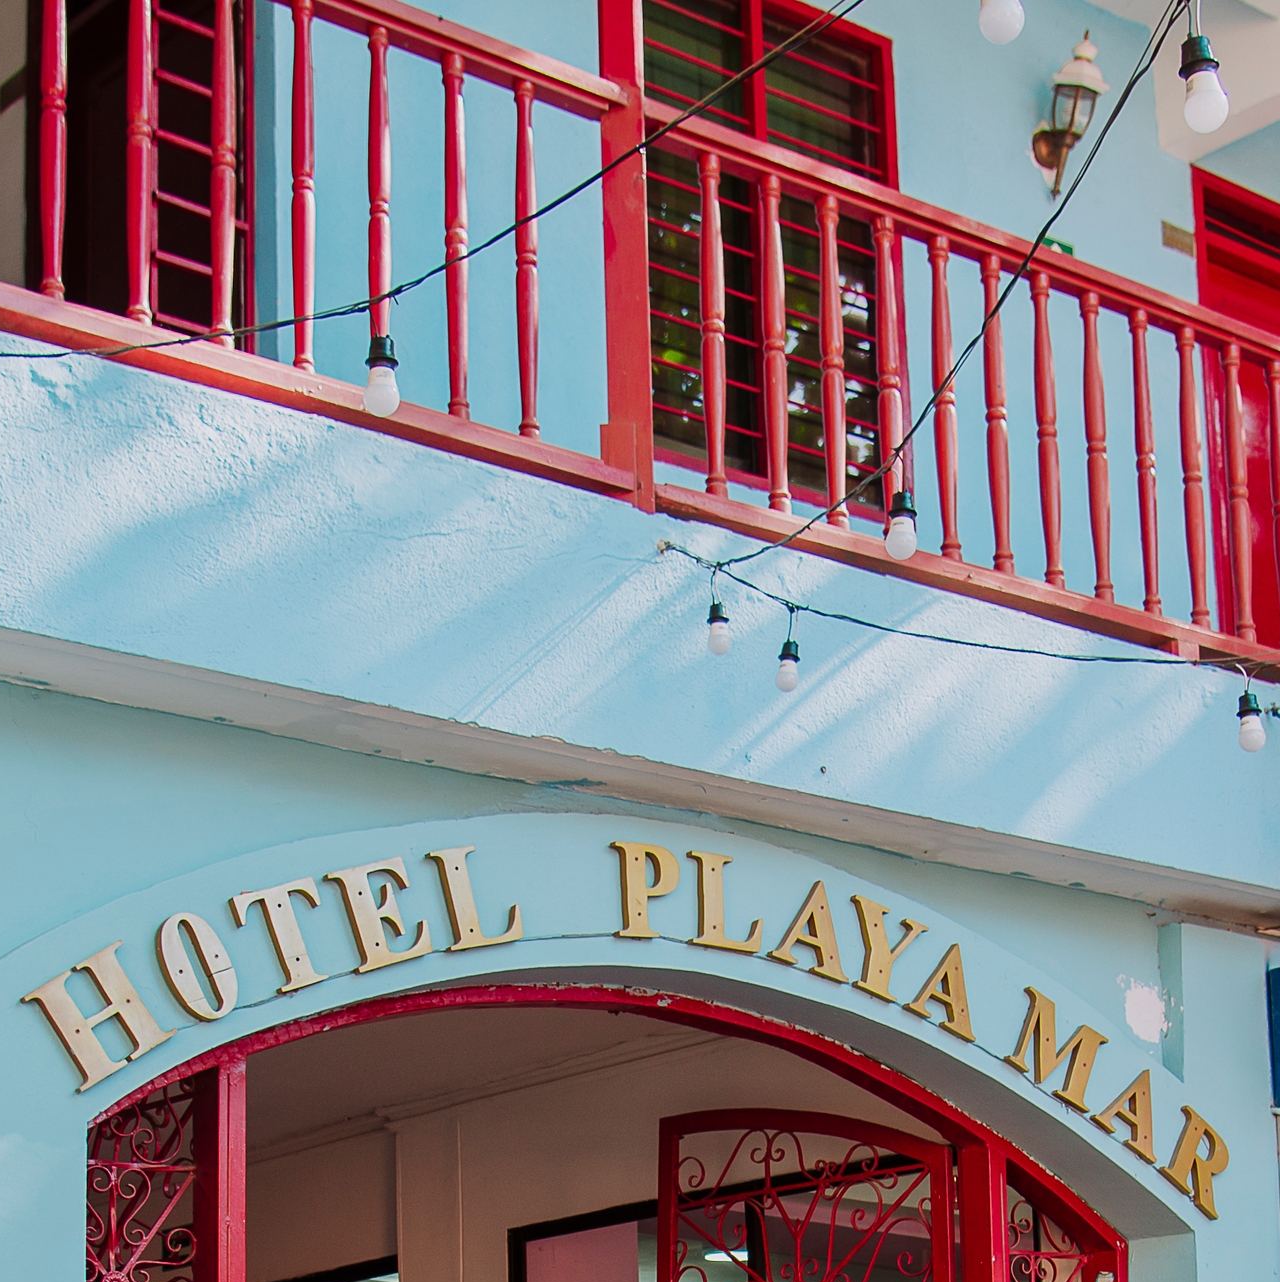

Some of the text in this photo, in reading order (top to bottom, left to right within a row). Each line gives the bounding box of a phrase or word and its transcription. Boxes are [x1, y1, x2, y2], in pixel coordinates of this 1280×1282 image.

[21, 841, 1230, 1220] HOTEL PLAYA MAR
